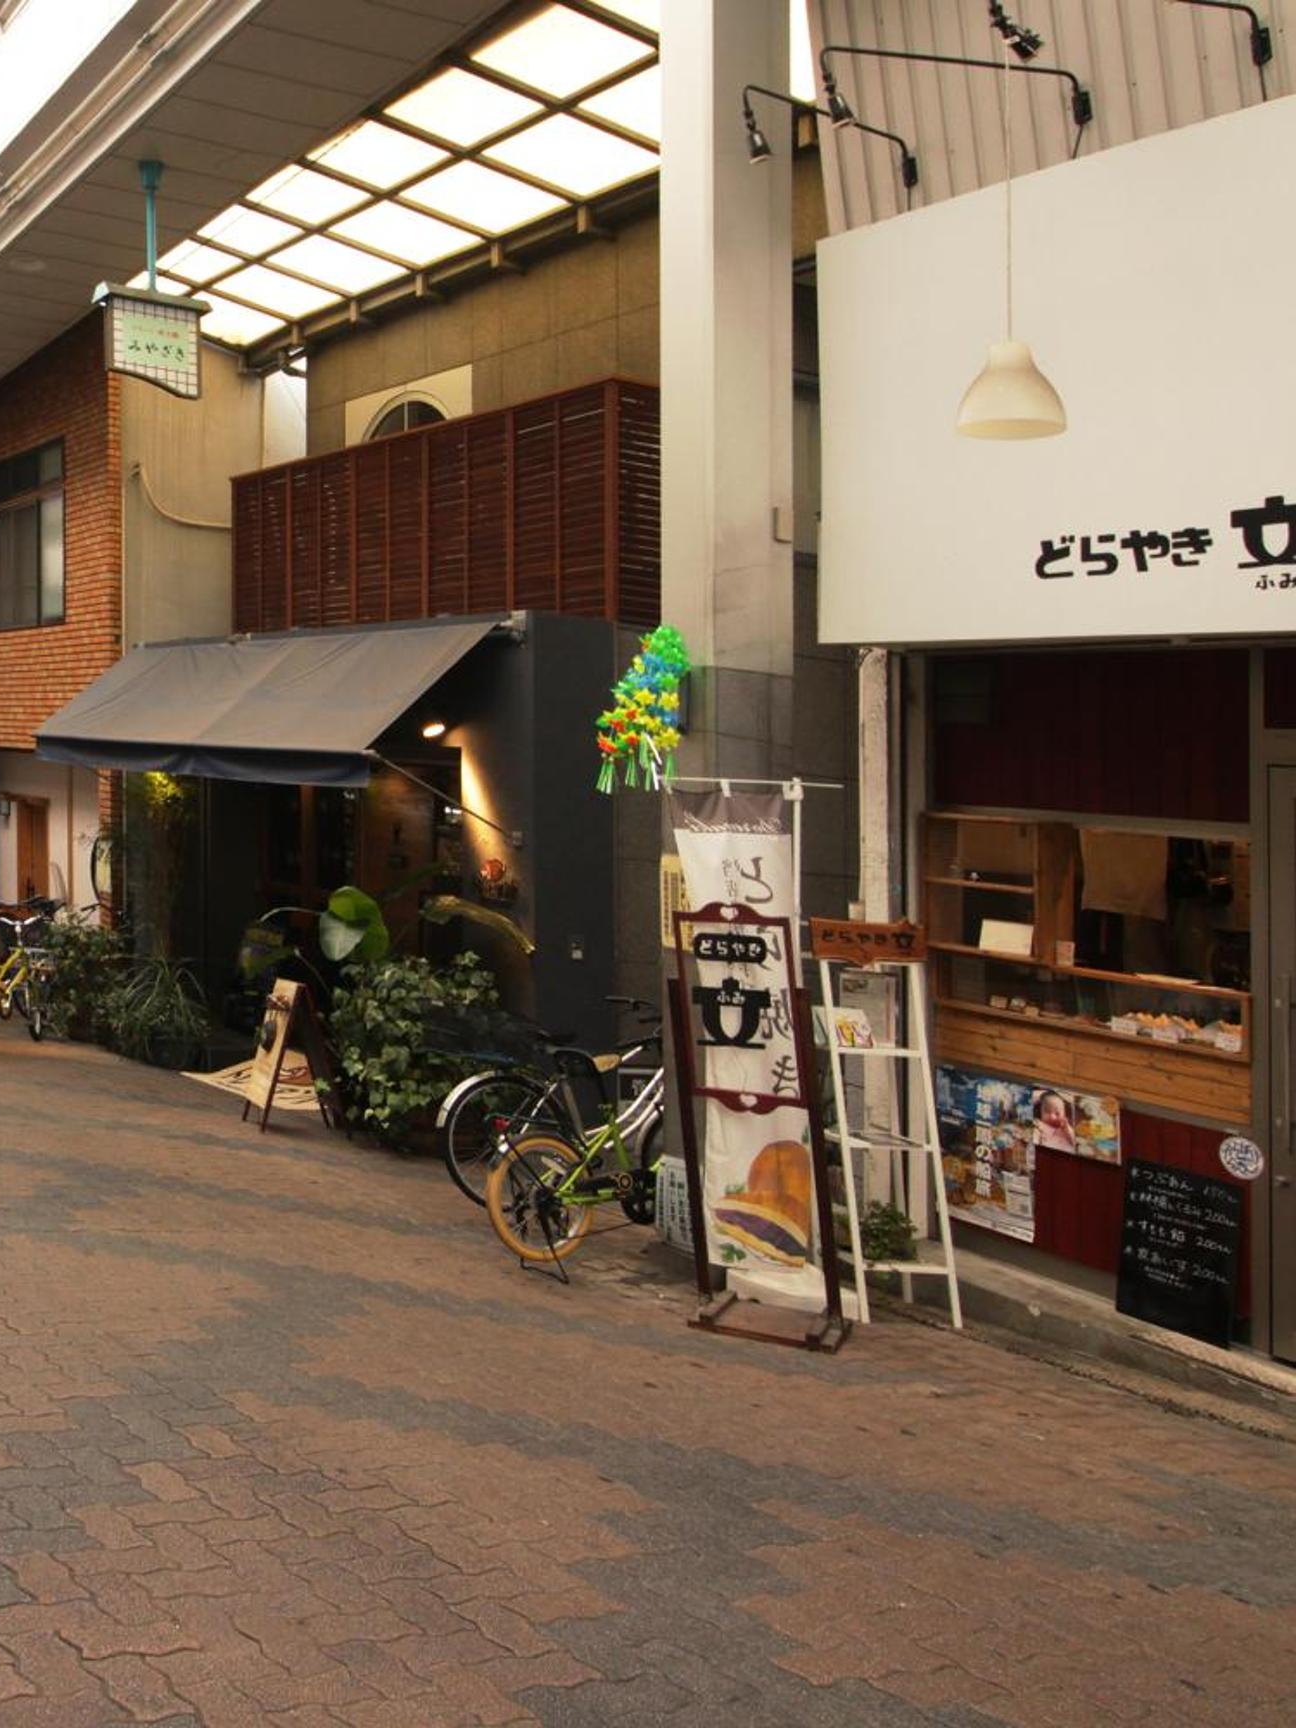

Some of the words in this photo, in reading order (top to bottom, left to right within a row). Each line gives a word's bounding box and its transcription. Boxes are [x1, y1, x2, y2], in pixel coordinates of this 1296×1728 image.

[1035, 527, 1212, 579] どらやき
[822, 929, 887, 944] どらやき
[698, 939, 764, 957] どらやき
